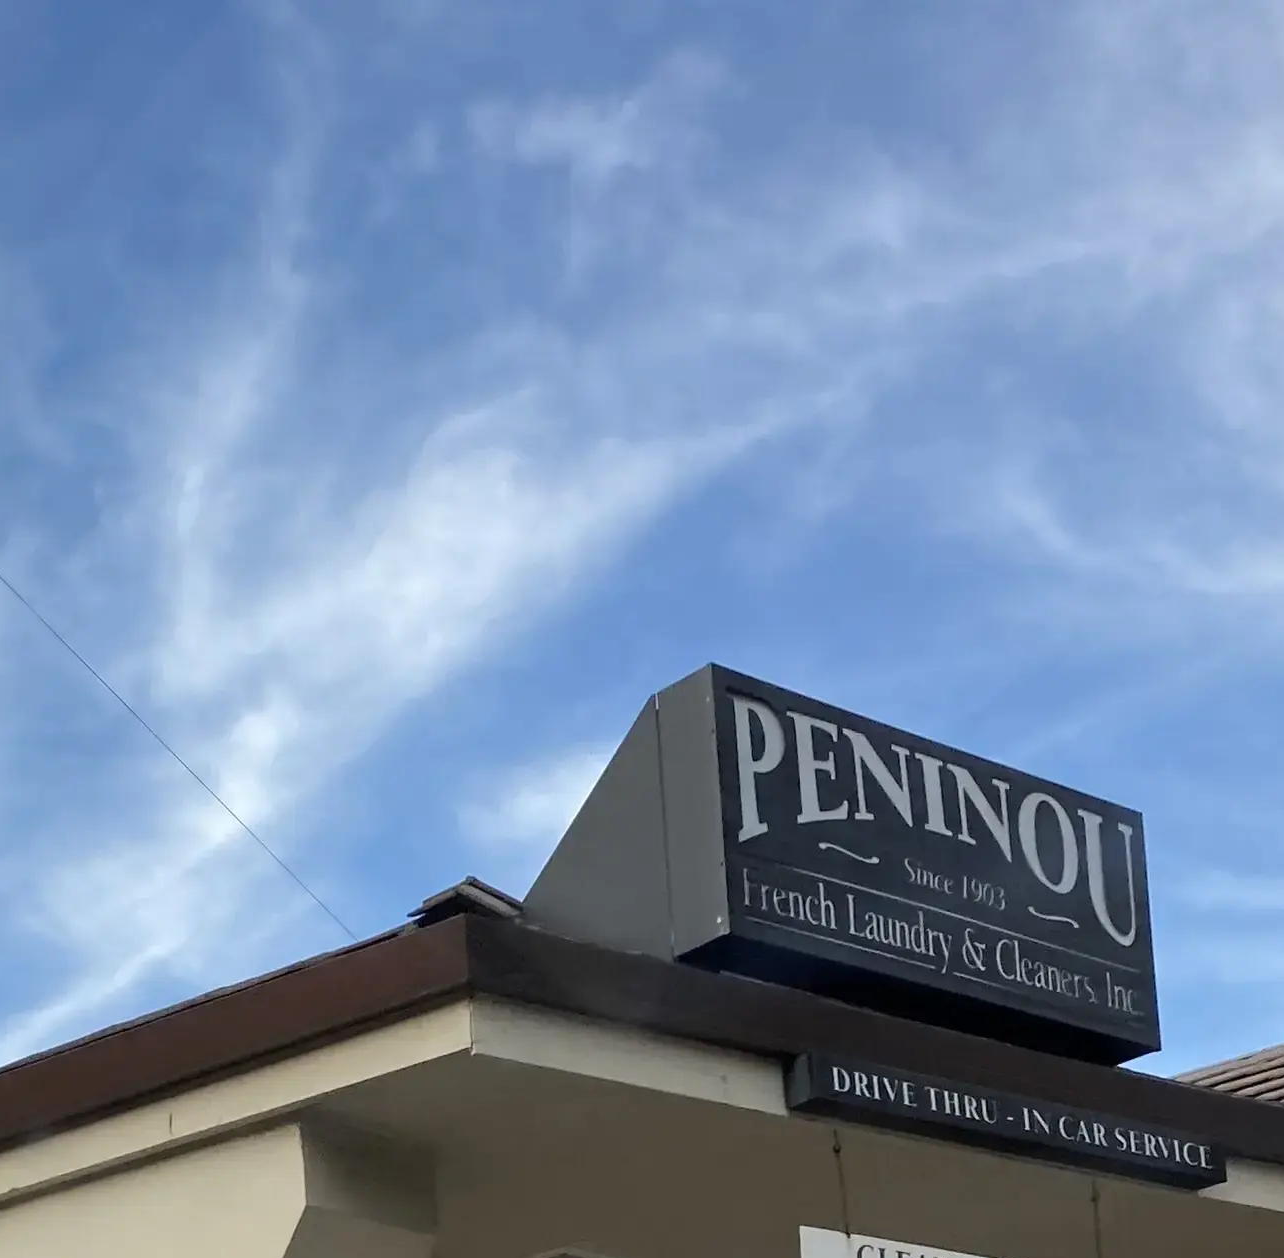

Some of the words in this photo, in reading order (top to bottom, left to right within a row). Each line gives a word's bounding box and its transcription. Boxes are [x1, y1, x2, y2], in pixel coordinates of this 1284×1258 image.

[731, 696, 1137, 948] PENINOU
[742, 867, 838, 930] French
[846, 893, 953, 974] Laundry
[962, 927, 987, 972] &
[904, 858, 954, 895] Since
[962, 875, 1006, 911] 1903
[831, 1065, 918, 1109] DRIVE
[923, 1085, 999, 1125] THRU
[1022, 1106, 1053, 1136] IN
[1058, 1115, 1110, 1148] CAR
[1114, 1126, 1214, 1170] SERVICE
